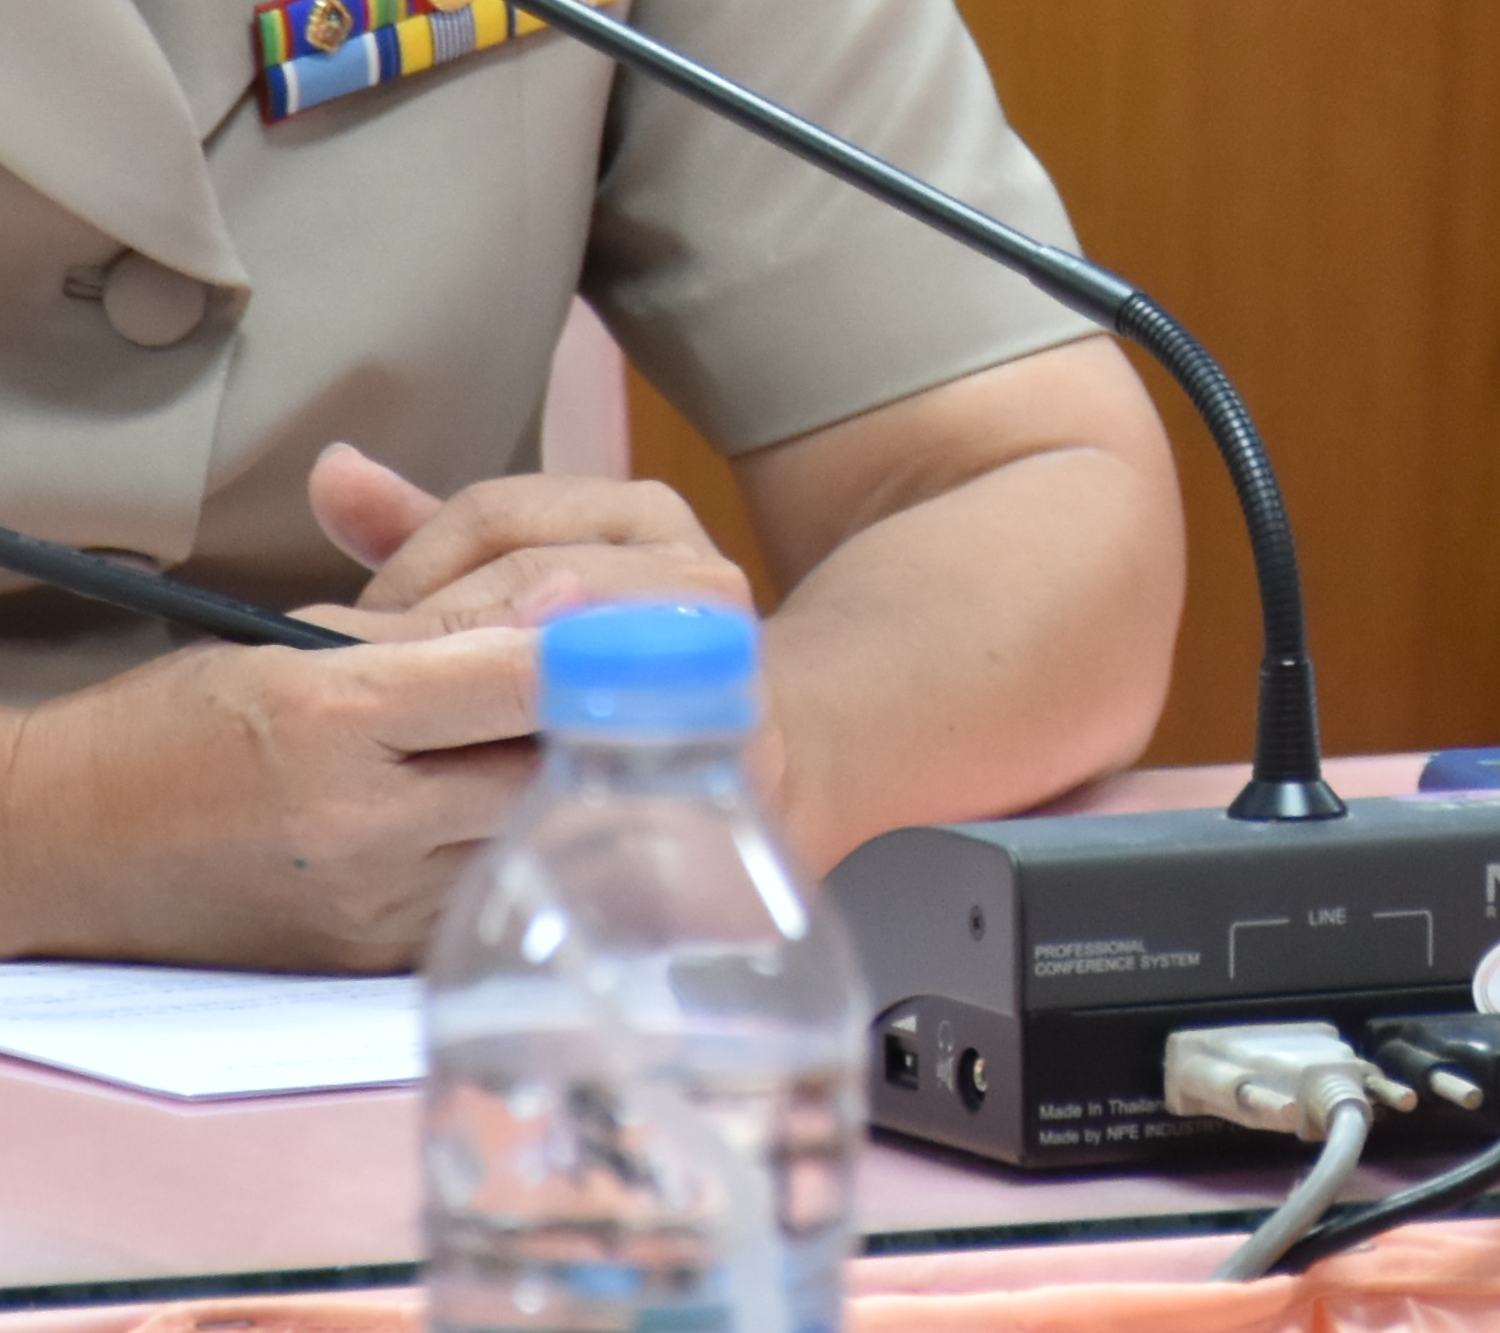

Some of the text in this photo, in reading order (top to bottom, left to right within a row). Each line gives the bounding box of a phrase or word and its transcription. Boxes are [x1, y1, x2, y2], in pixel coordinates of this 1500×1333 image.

[1308, 907, 1346, 926] LINE
[1034, 940, 1145, 959] PROFESSIONAL
[1034, 953, 1200, 976] CONFERENCE SYSTEM
[1039, 1103, 1082, 1121] Made
[1039, 1130, 1080, 1145] Made
[1084, 1127, 1102, 1145] by
[1106, 1122, 1139, 1141] NPE
